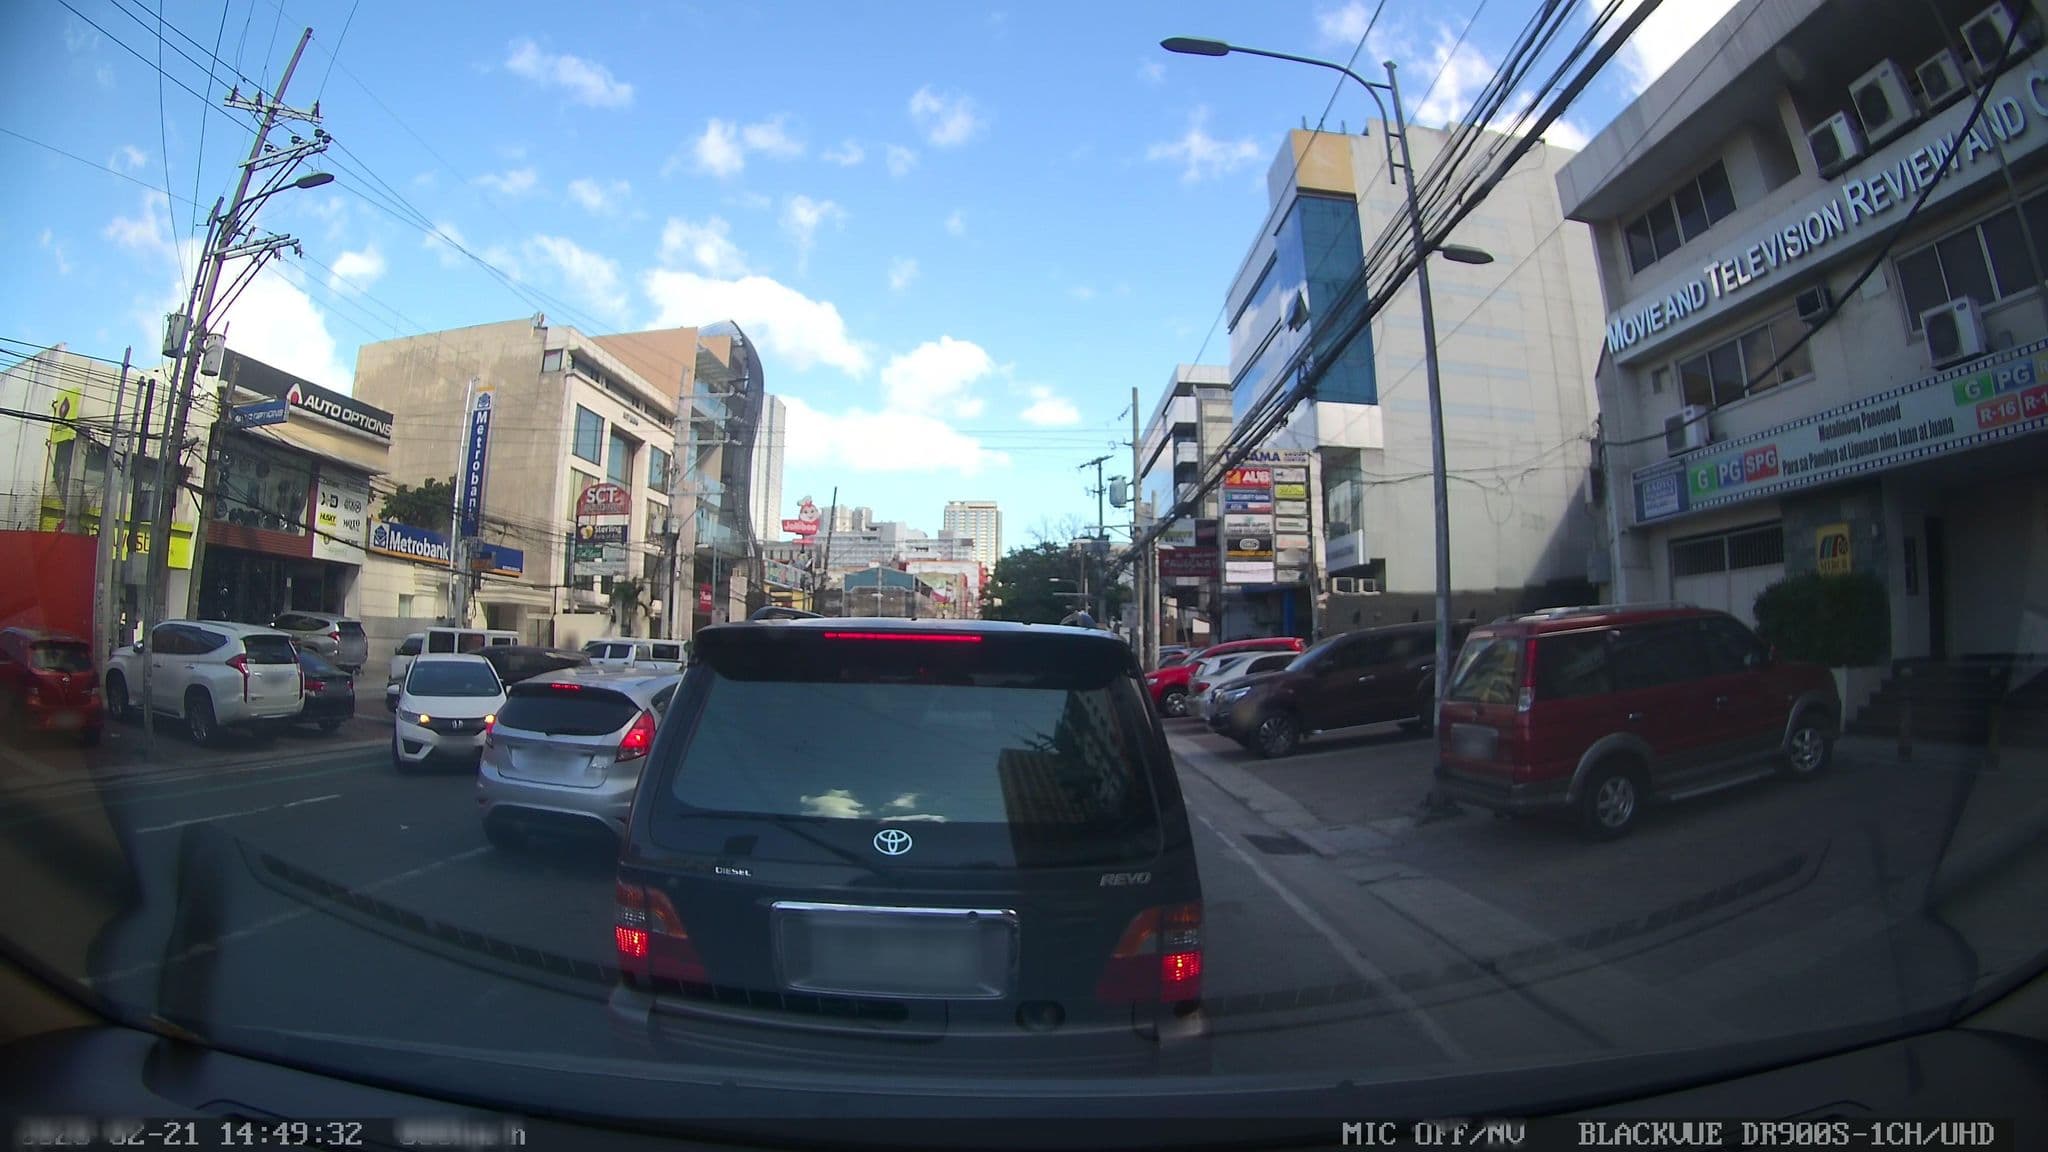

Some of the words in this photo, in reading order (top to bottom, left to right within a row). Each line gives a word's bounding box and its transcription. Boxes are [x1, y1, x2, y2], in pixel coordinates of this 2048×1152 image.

[1607, 300, 1664, 354] MOVIE
[1666, 281, 1705, 324] AND
[1704, 199, 1844, 298] TELEVISION
[1843, 132, 1959, 223] REVIEW
[1966, 97, 2025, 161] AND
[1965, 382, 1981, 399] G
[1997, 366, 2031, 391] PG
[305, 394, 341, 419] AUTO
[342, 409, 392, 437] OPTIONS
[1980, 399, 2017, 423] R-16
[1838, 445, 1848, 461] at
[1898, 426, 1918, 446] Juan
[1918, 424, 1928, 441] at
[1928, 416, 1955, 439] Juana
[1242, 470, 1270, 484] AUB
[1697, 470, 1708, 489] G
[1718, 460, 1742, 485] PG
[1745, 450, 1778, 474] SPG
[389, 530, 450, 561] Metrobank
[715, 866, 752, 877] DIESEL
[1099, 872, 1152, 887] REVO
